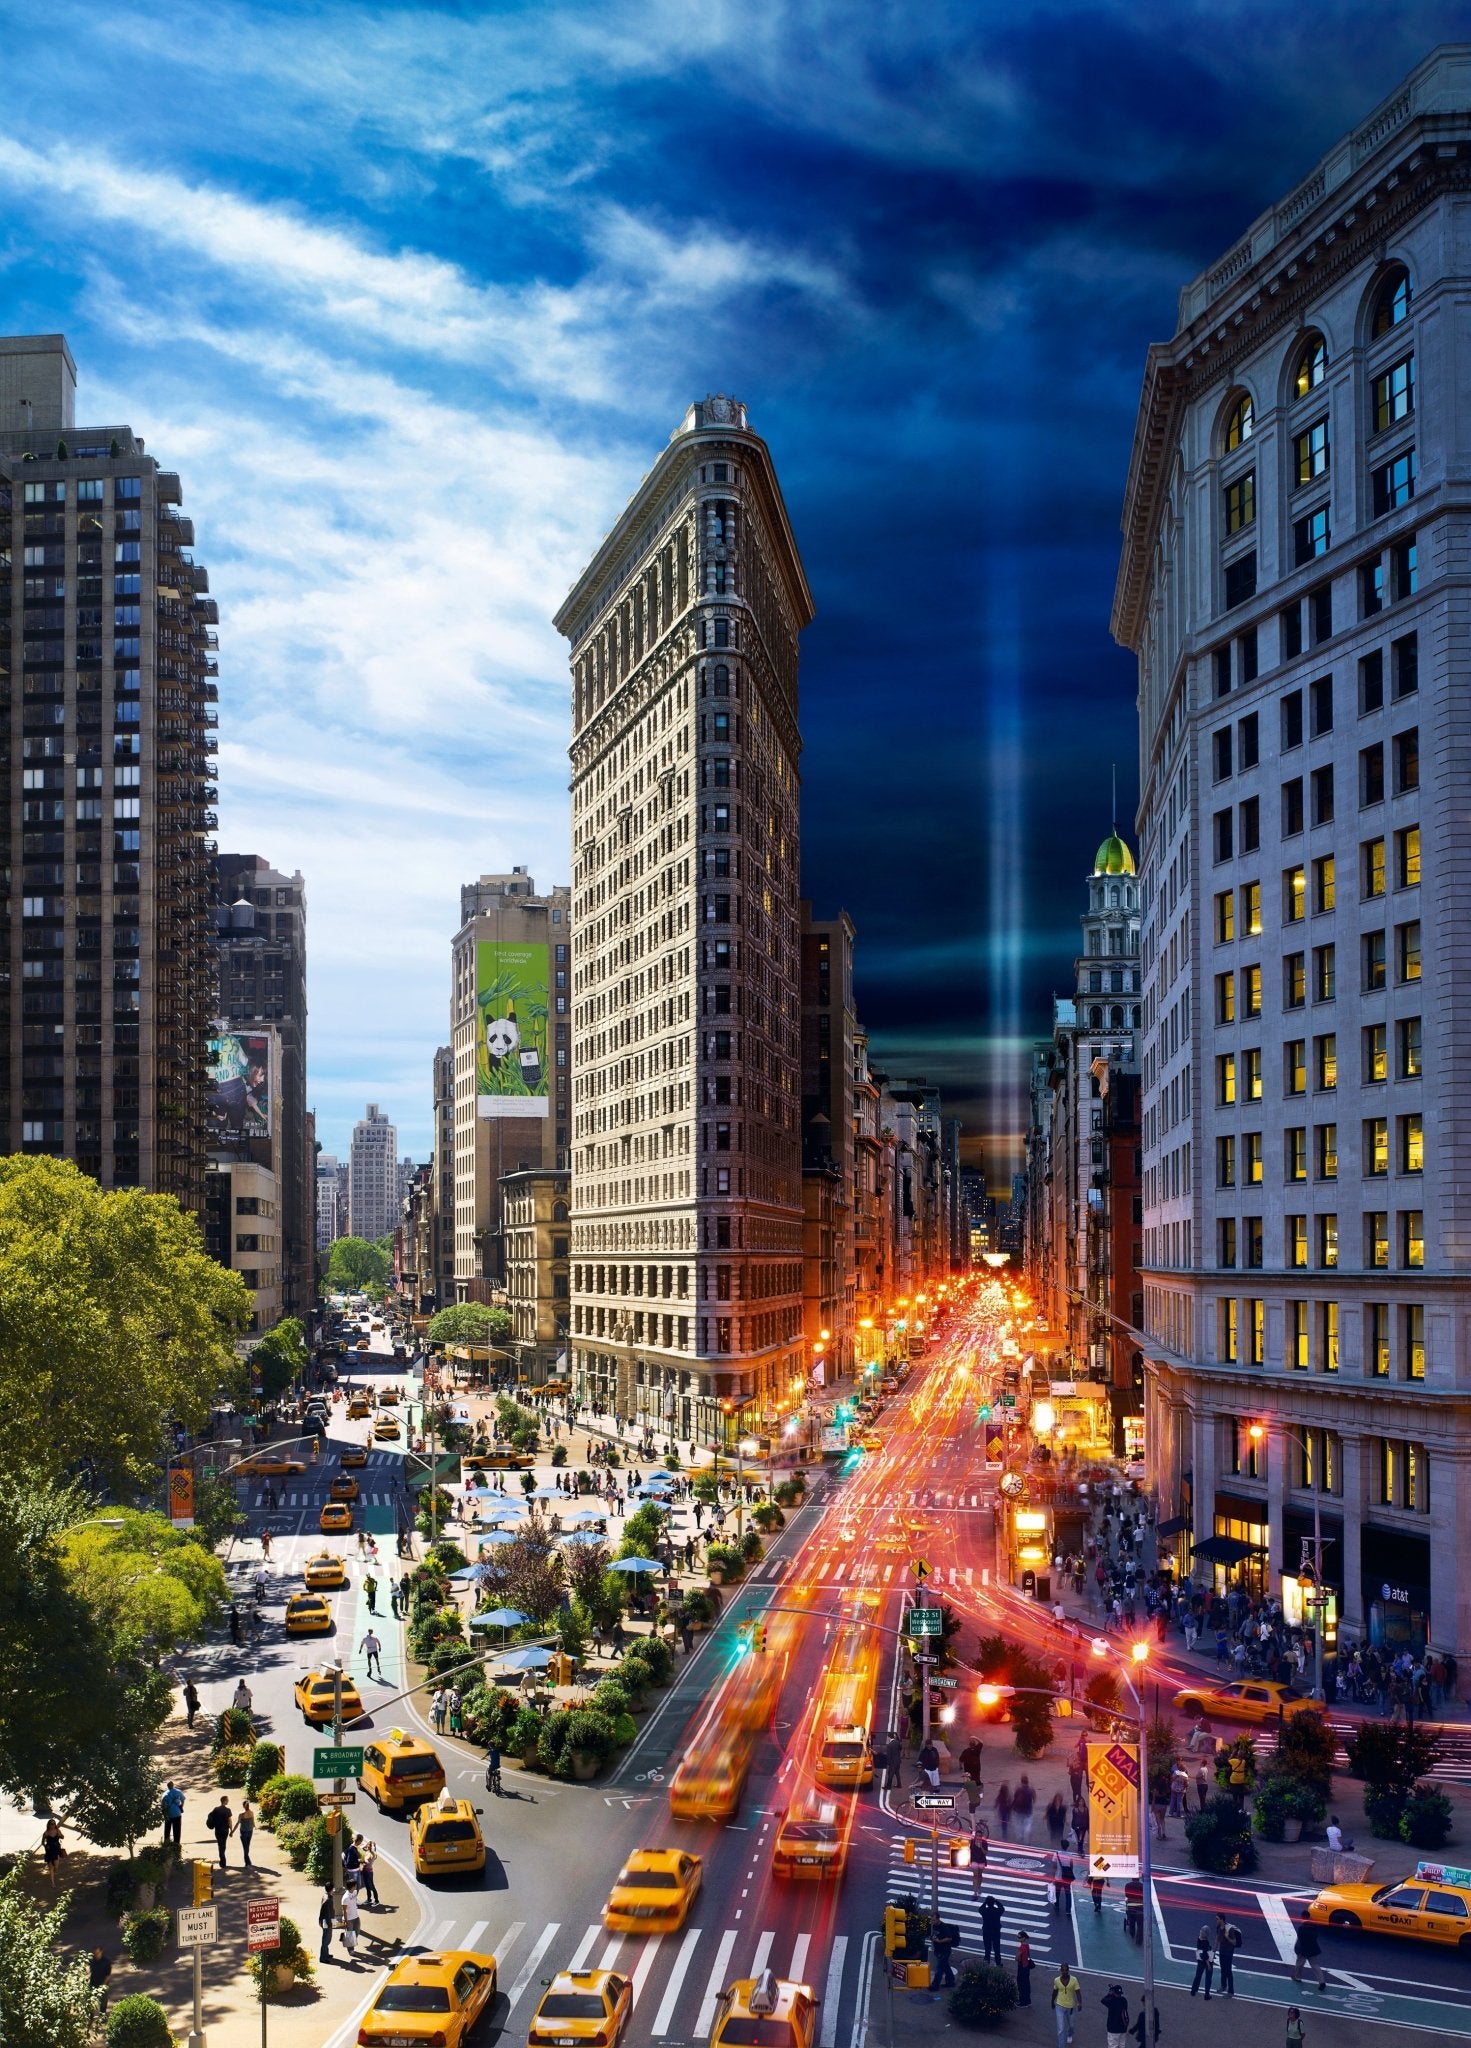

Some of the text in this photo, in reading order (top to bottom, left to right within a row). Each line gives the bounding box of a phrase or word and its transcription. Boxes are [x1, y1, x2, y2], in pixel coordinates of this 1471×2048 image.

[1391, 1587, 1408, 1603] at&t
[1096, 1763, 1118, 1792] SQ.
[256, 1904, 278, 1912] STANDING
[198, 1911, 213, 1919] LANE
[251, 1911, 275, 1919] ANYTIME
[187, 1922, 207, 1931] MUST
